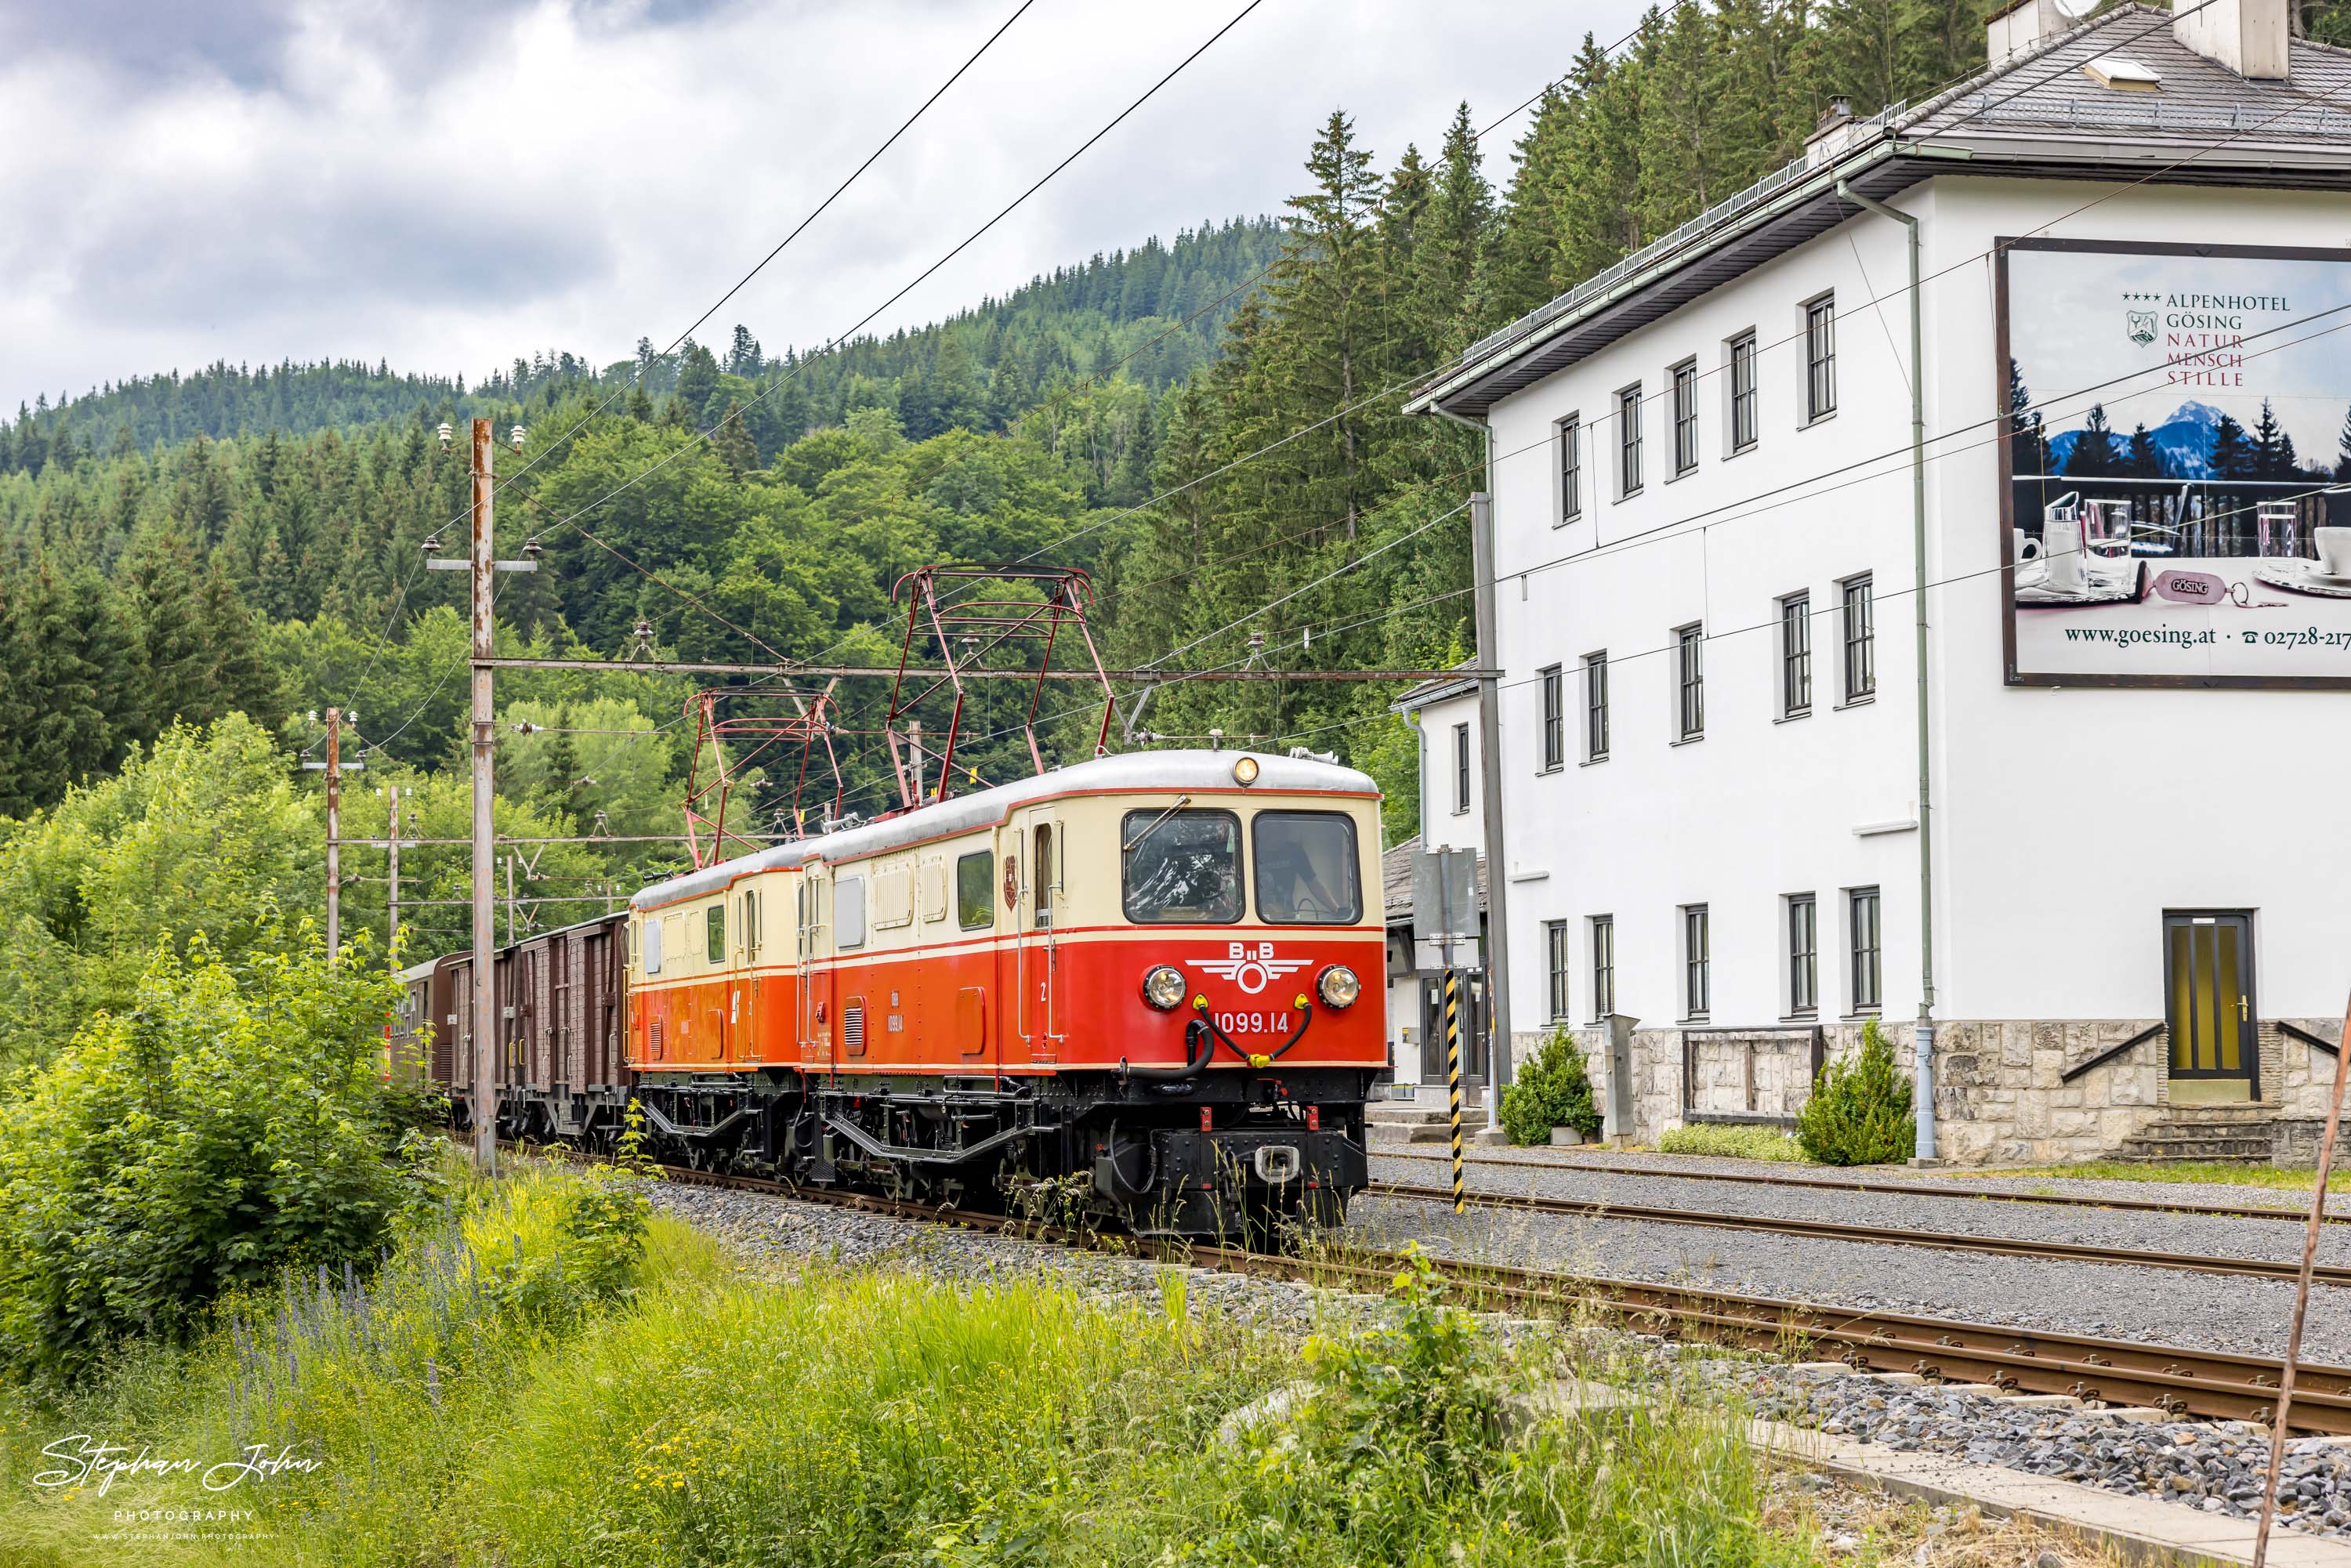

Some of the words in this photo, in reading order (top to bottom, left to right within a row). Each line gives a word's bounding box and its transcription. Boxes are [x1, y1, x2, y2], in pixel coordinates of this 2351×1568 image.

[2166, 294, 2291, 311] ALPENHOTEL
[2166, 311, 2242, 330] GÖSING
[2167, 333, 2244, 349] NATUR
[2168, 353, 2242, 368] MENSCH
[2168, 371, 2244, 386] STILLE
[2172, 578, 2208, 594] GÖSING
[2065, 624, 2216, 648] www.goesing.at
[1041, 981, 1046, 1001] 2
[1215, 1012, 1288, 1033] 1099.14
